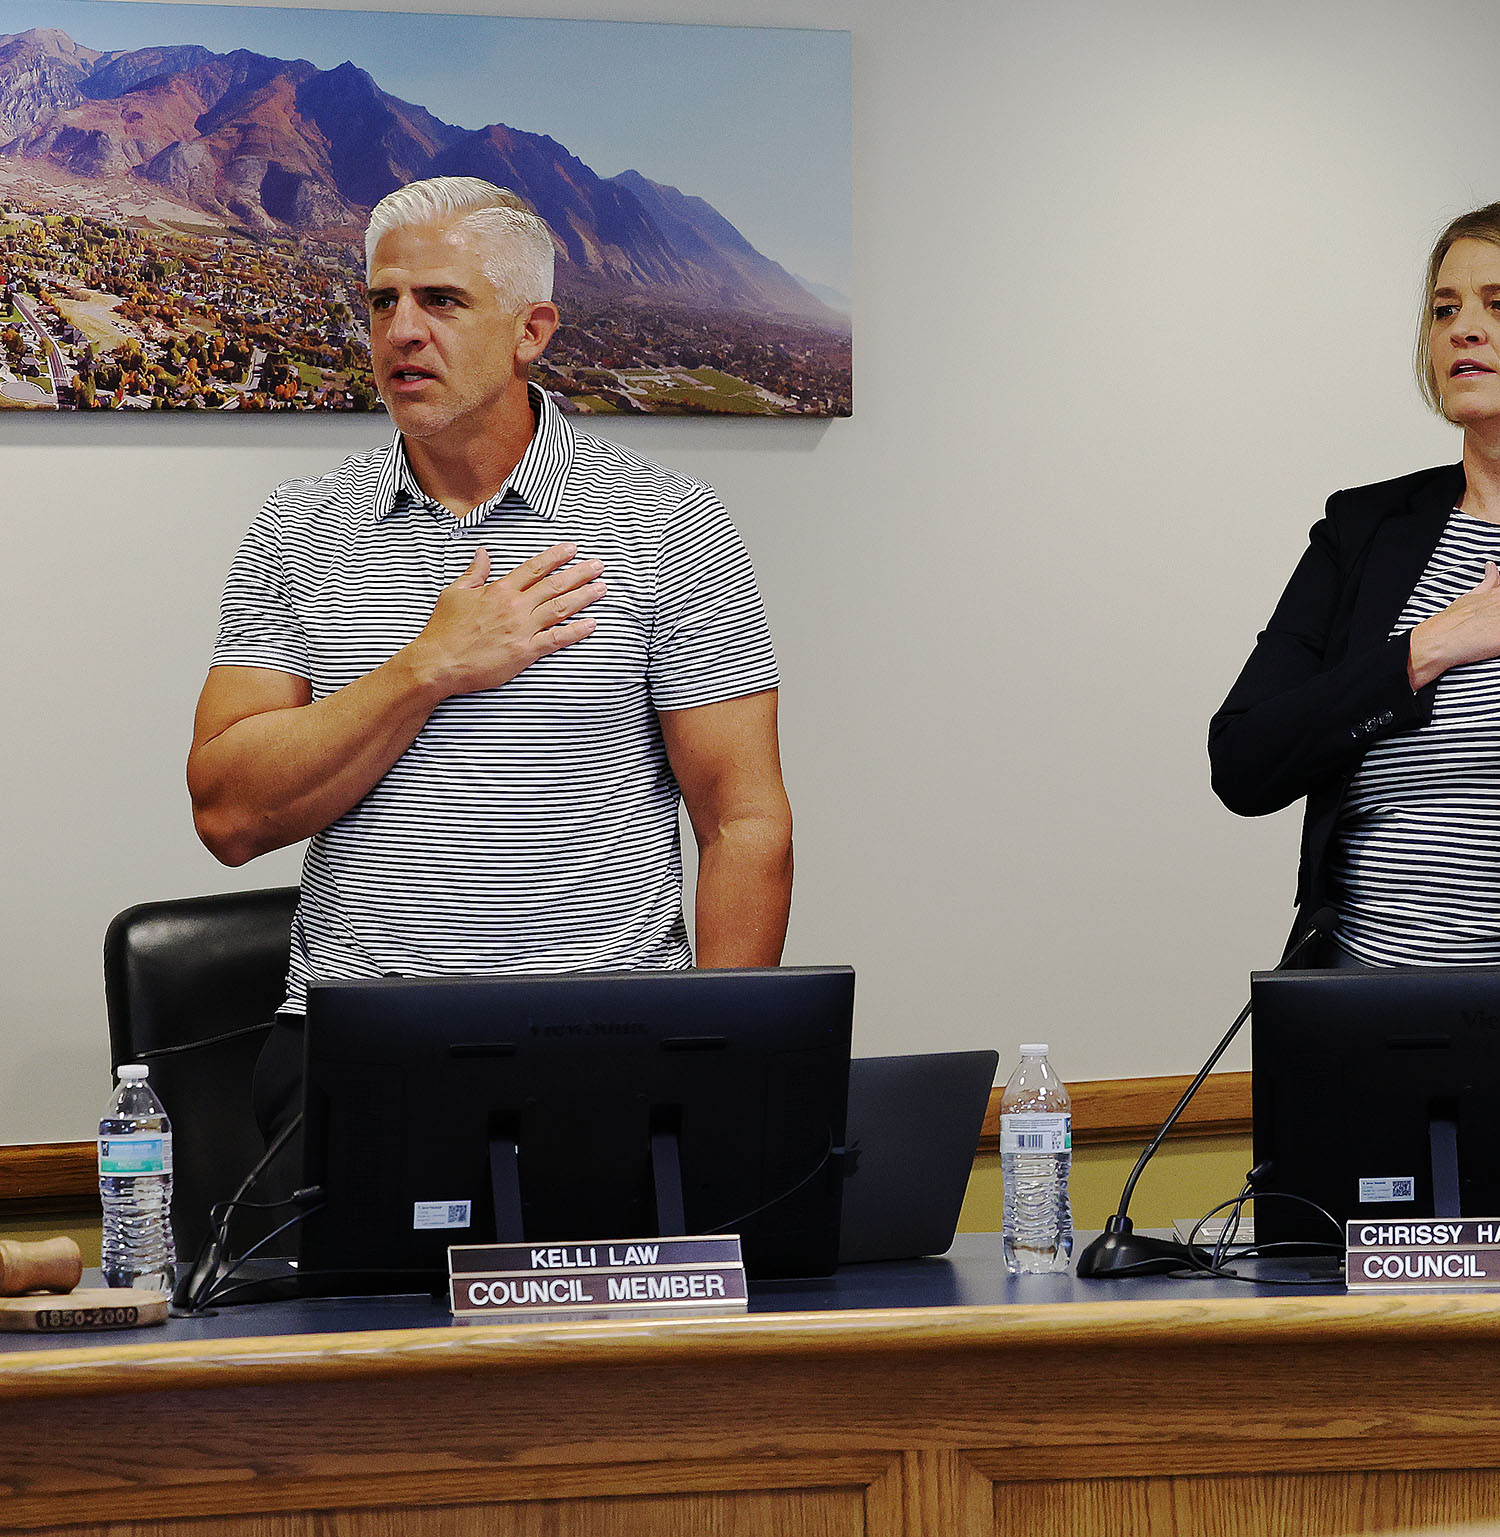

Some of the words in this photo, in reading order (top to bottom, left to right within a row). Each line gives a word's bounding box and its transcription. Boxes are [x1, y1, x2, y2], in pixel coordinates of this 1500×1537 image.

[1360, 1224, 1463, 1245] CHRISSY
[531, 1247, 597, 1268] KELLI
[609, 1245, 659, 1265] LAW
[1364, 1254, 1486, 1279] COUNCIL
[468, 1279, 593, 1305] COUNCIL
[607, 1275, 725, 1300] MEMBER
